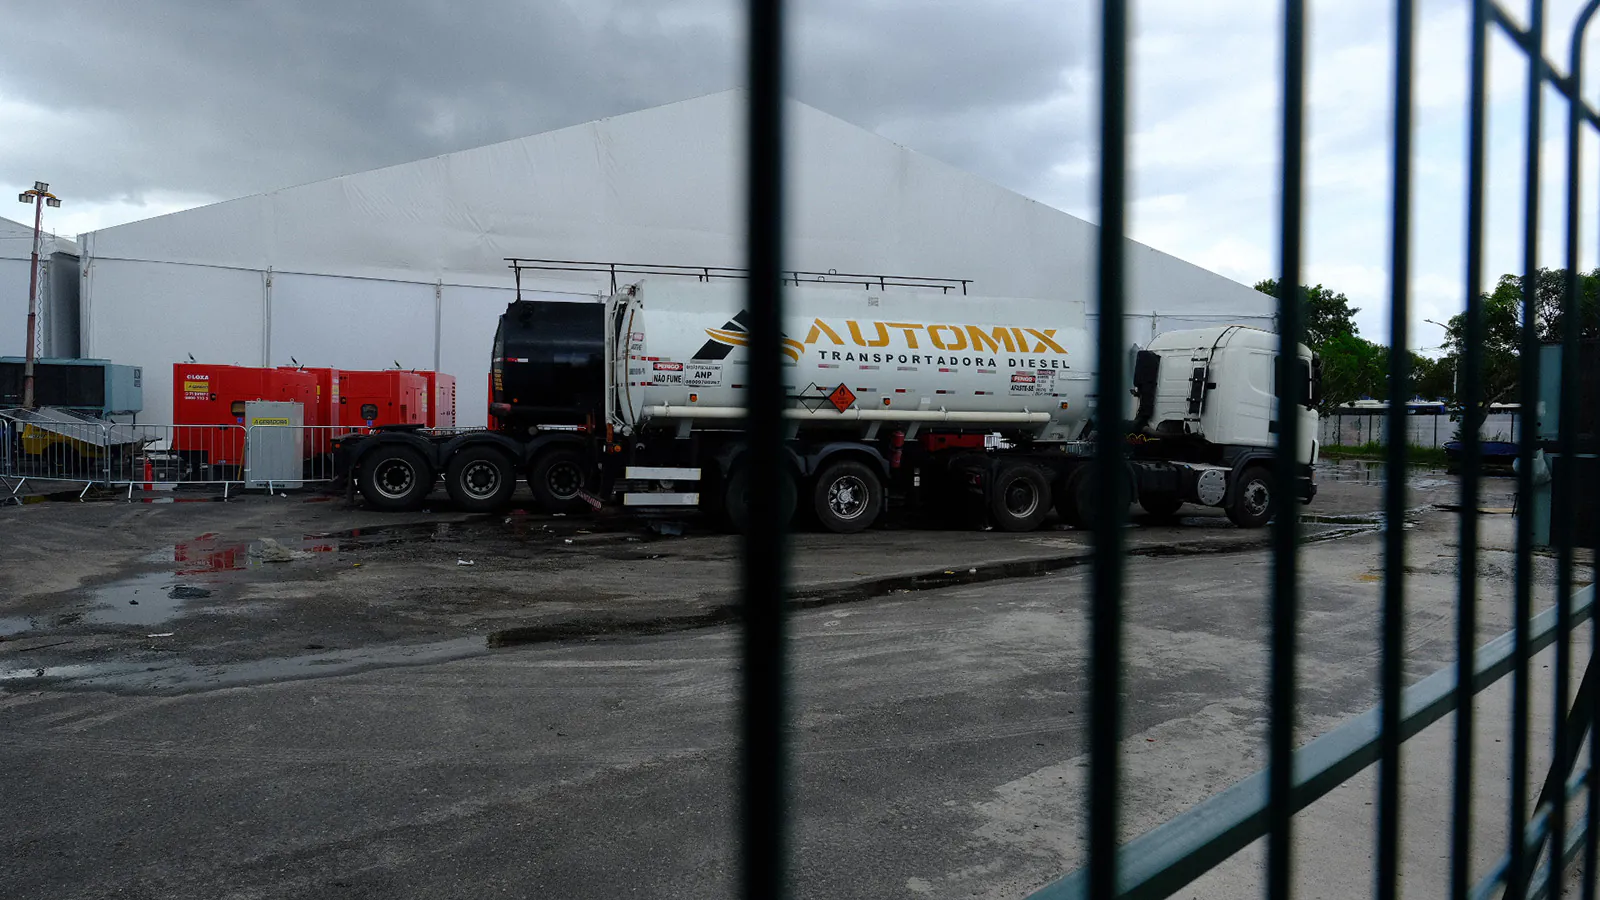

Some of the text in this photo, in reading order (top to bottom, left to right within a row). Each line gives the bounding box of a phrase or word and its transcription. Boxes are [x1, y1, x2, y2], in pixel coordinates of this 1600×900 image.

[804, 318, 1068, 354] AUTOMIX
[819, 351, 1070, 368] TRANSPORTADORA DIESEL
[654, 373, 682, 384] NÃO FUME
[694, 371, 712, 379] ANP
